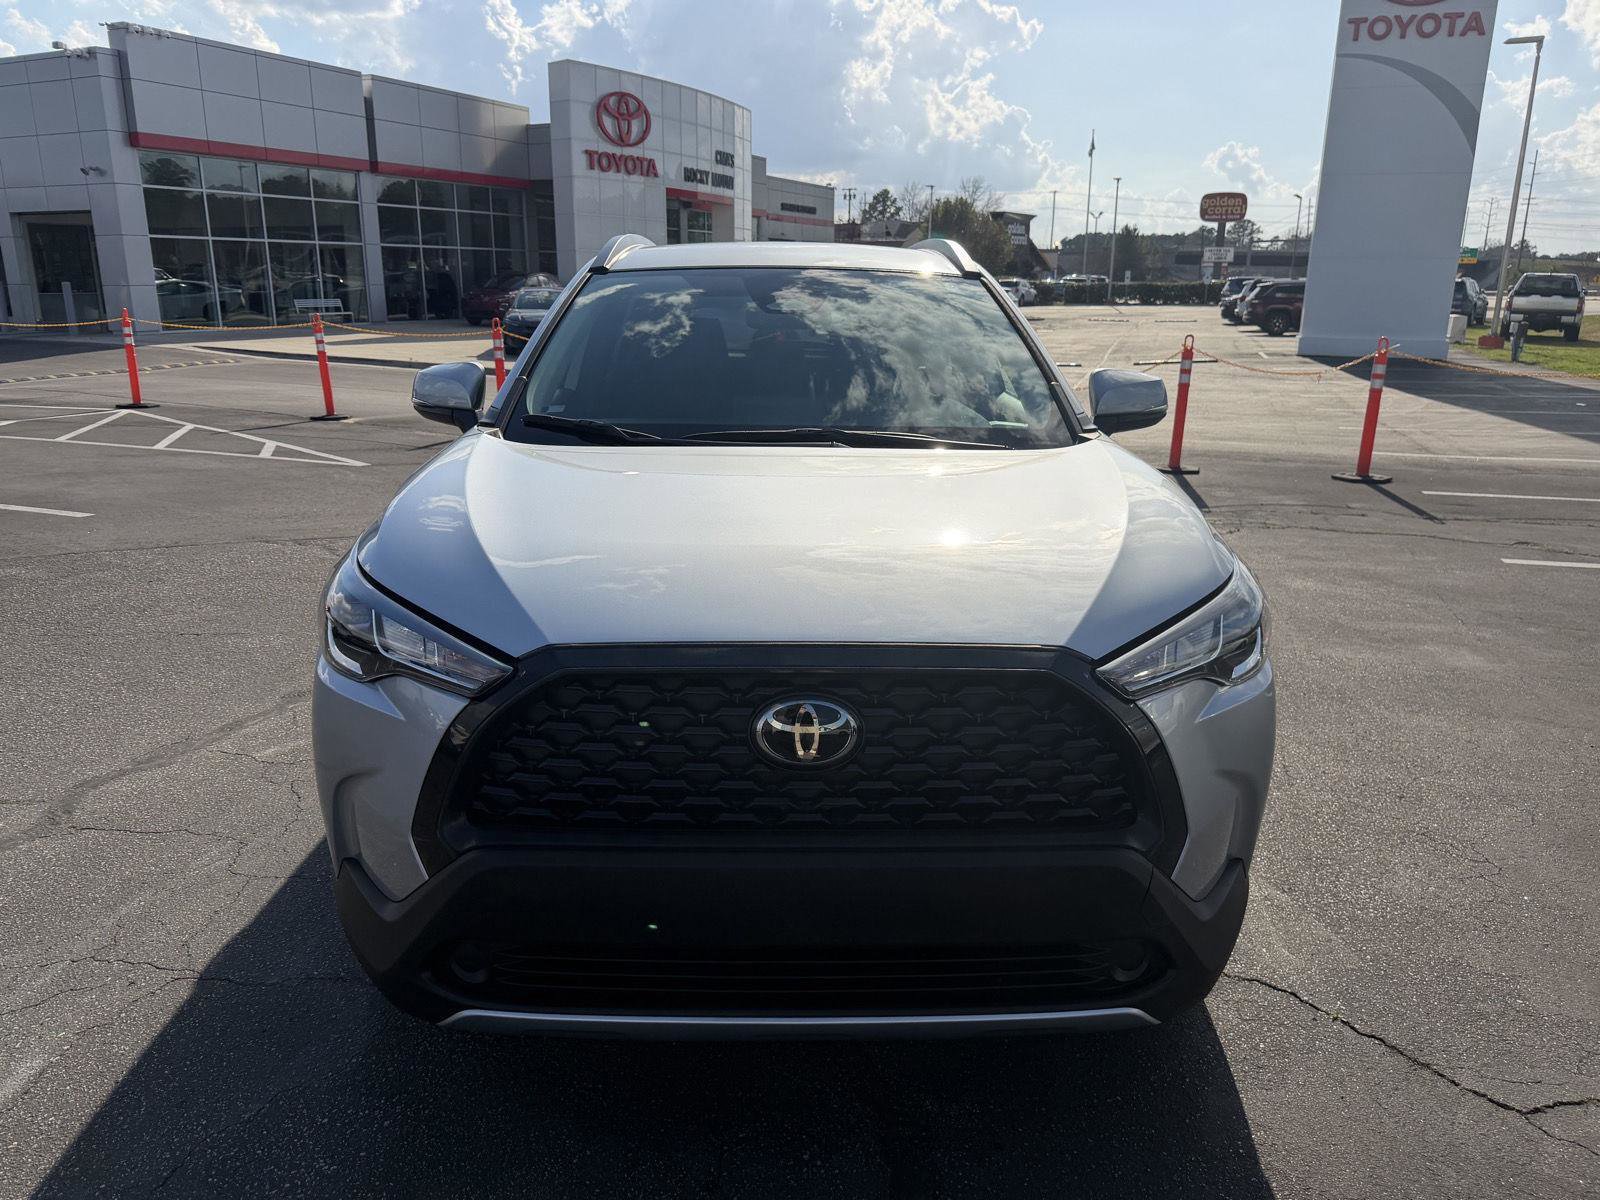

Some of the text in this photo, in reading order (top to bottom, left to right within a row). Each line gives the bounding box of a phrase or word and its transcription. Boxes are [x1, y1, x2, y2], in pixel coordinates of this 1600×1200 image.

[1347, 11, 1486, 42] TOYOTA
[584, 149, 659, 177] TOYOTA
[683, 167, 710, 185] ROCKY
[1202, 196, 1243, 208] golden
[1207, 205, 1246, 214] corral
